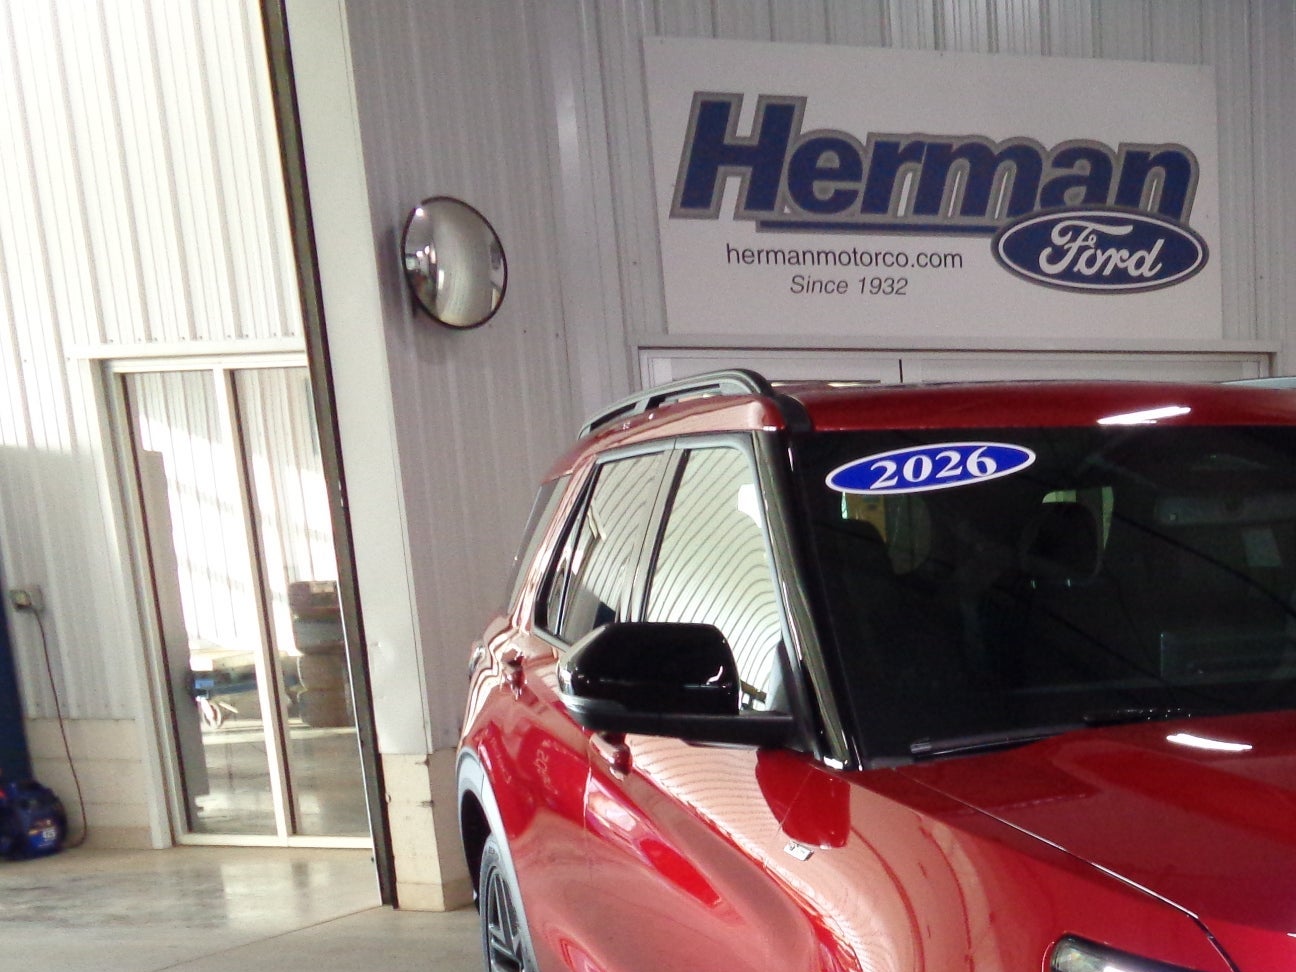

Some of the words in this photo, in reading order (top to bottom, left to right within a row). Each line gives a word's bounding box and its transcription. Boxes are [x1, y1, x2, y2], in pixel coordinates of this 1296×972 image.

[670, 91, 1201, 223] Herman
[726, 243, 963, 271] hermanmotorco.com
[1038, 222, 1163, 278] Ford
[790, 274, 848, 295] Since
[858, 274, 908, 295] 1932
[870, 446, 997, 490] 2026
